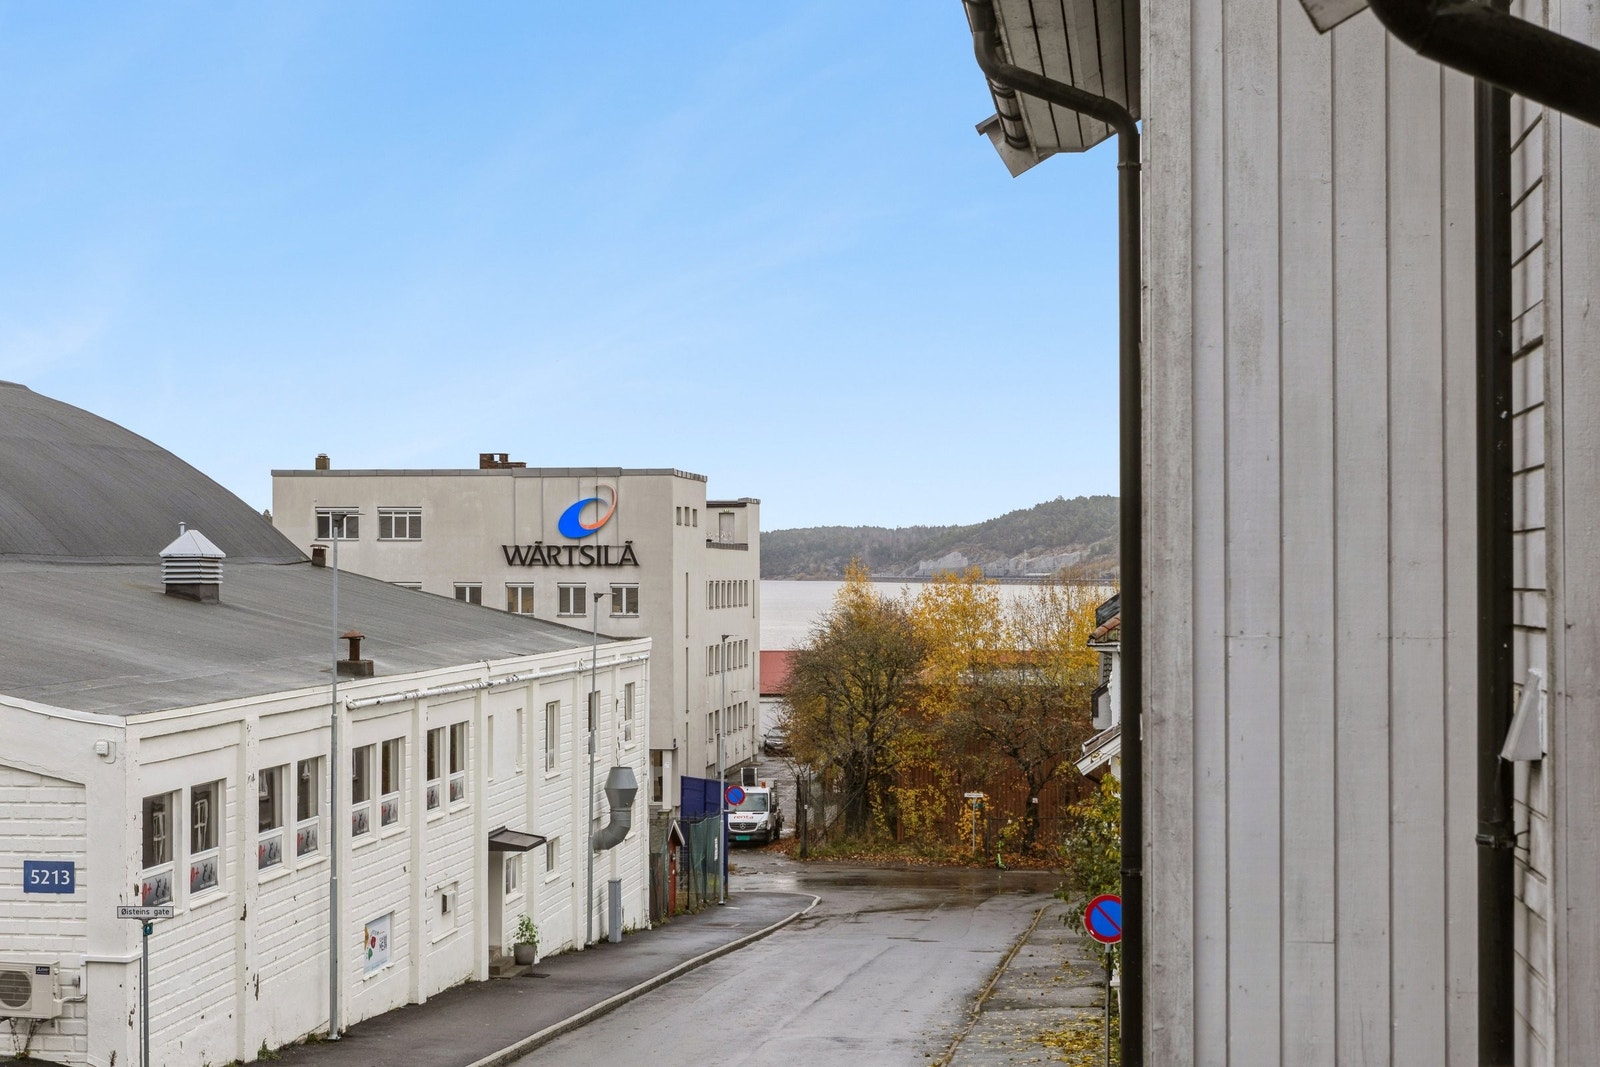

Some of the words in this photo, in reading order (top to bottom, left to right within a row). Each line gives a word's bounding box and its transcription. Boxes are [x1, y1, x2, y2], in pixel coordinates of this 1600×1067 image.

[501, 540, 640, 567] WÄRTSILÄ
[30, 869, 71, 885] 5213
[153, 908, 170, 917] gate
